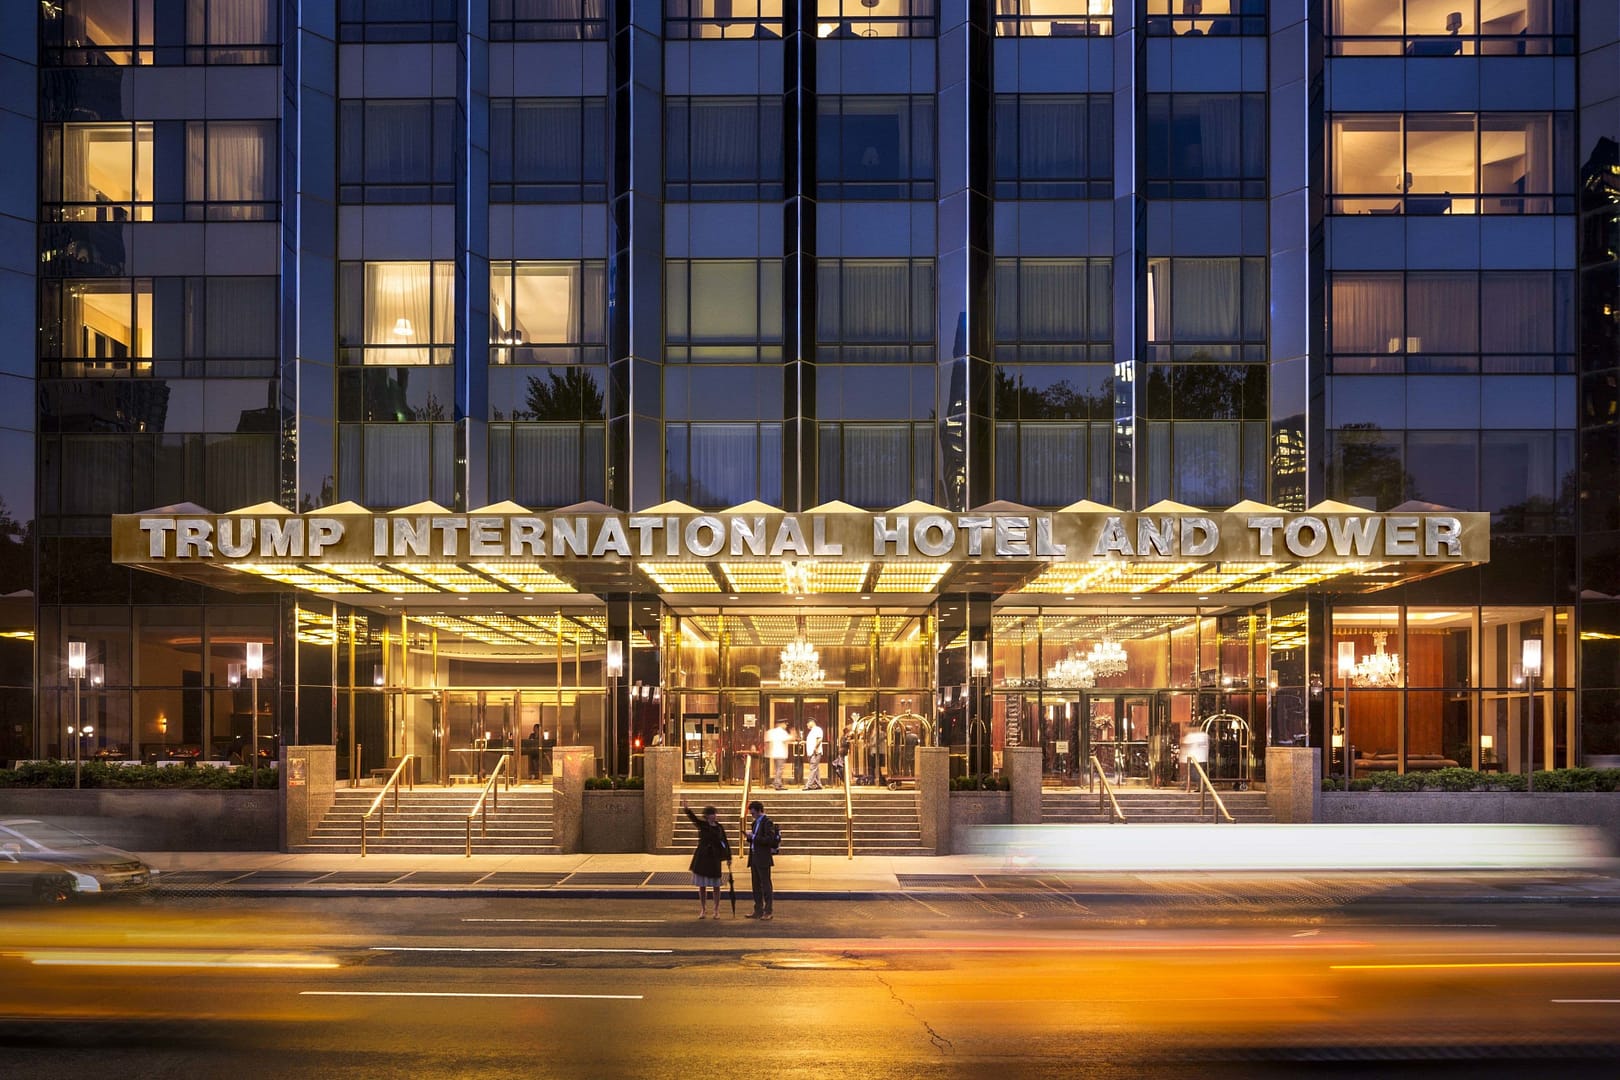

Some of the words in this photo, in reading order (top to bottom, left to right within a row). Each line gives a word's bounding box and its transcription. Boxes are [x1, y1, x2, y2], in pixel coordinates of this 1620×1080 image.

[141, 518, 344, 557] TRUMP
[373, 517, 843, 557] INTERNATIONAL
[873, 517, 1067, 557] HOTEL
[1094, 516, 1220, 557] AND
[1247, 516, 1463, 557] TOWER
